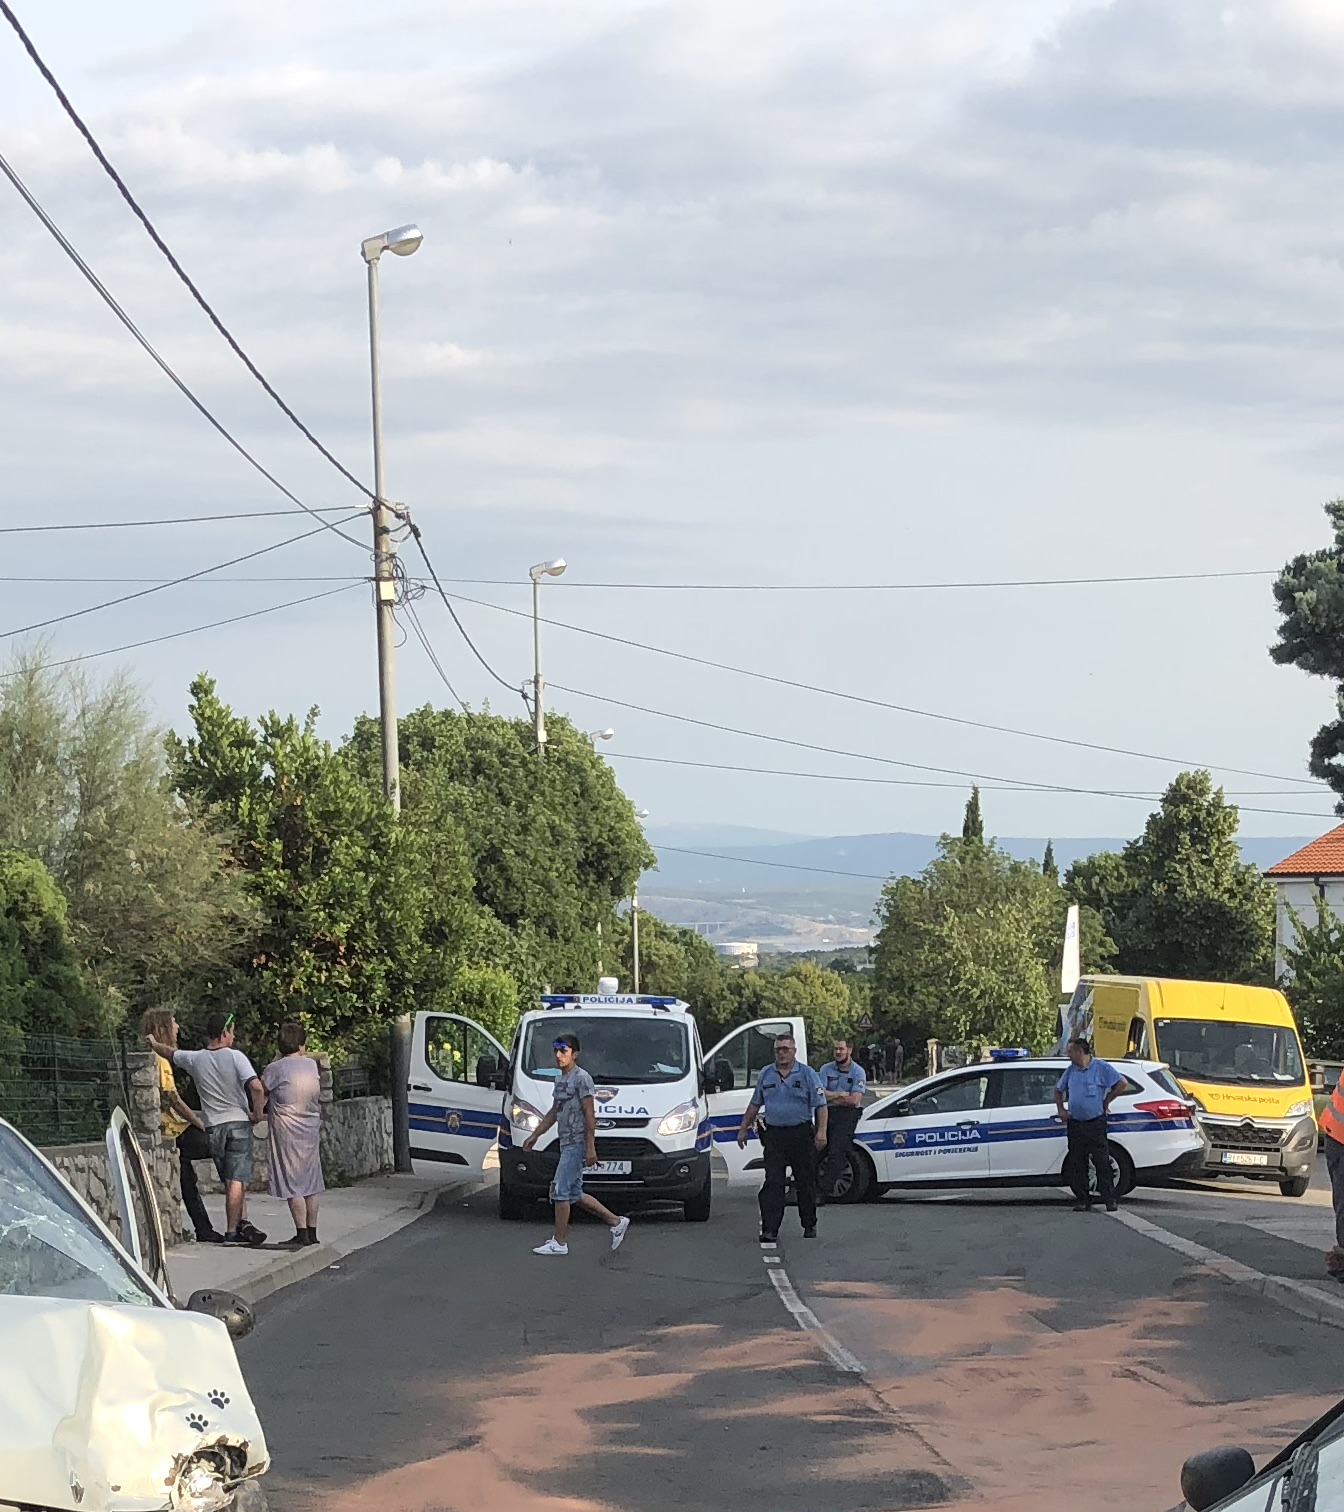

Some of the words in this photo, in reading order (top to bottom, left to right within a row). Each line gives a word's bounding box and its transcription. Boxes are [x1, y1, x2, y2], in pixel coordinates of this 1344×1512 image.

[582, 996, 634, 1004] POLICIJA
[598, 1105, 649, 1115] ICIJA
[916, 1130, 981, 1143] POLICIJA
[606, 1161, 624, 1172] 774
